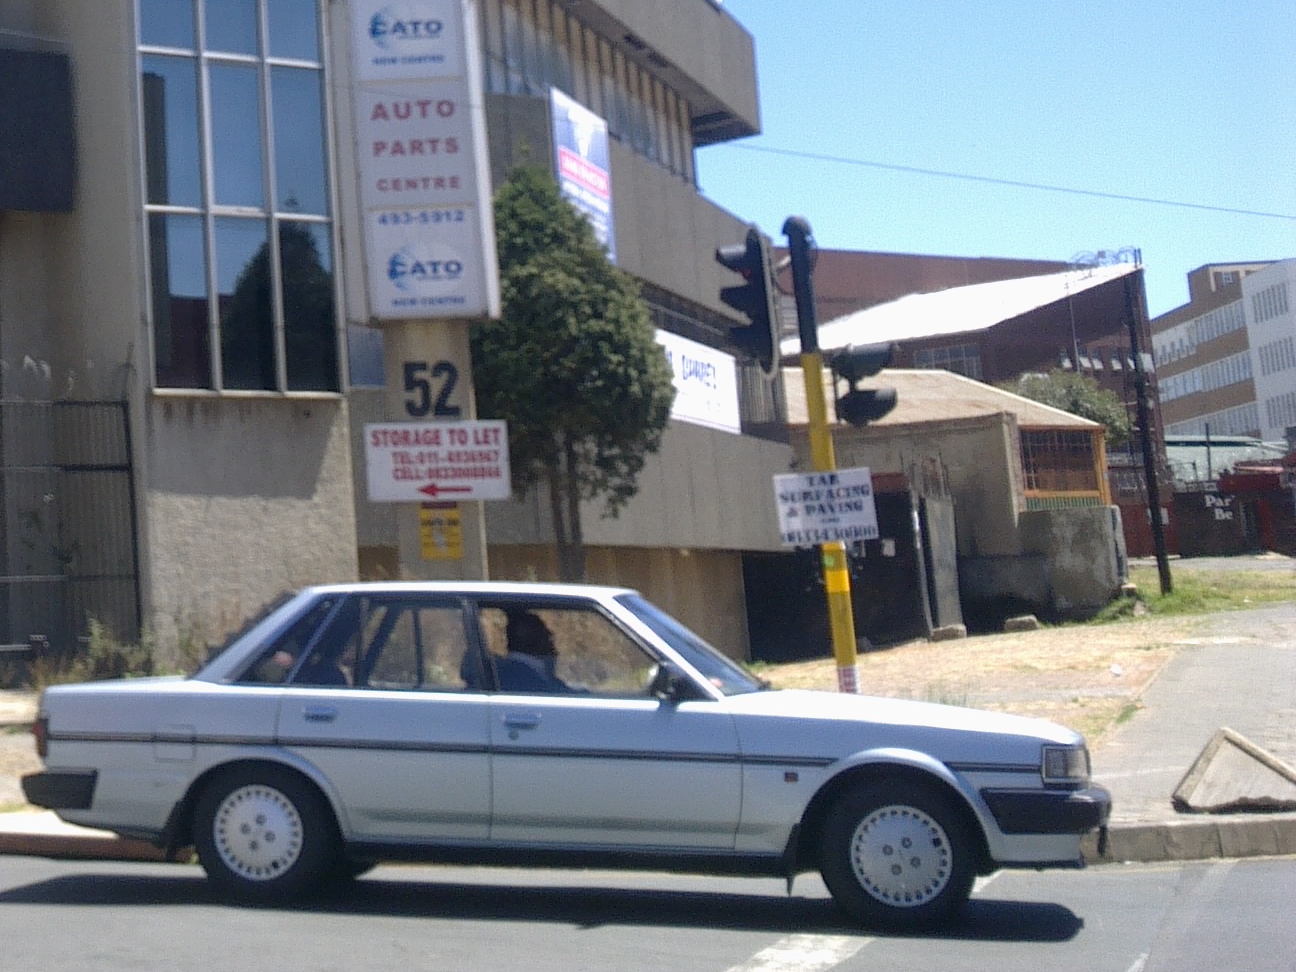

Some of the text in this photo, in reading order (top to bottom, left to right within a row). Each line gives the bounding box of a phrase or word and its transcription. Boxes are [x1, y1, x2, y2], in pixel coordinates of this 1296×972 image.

[370, 99, 455, 121] AUTO
[371, 137, 460, 157] PARTS
[376, 175, 460, 192] CENTRE
[403, 360, 461, 417] 52
[371, 428, 500, 447] STORAGE TO LET
[781, 485, 869, 502] SURFACING
[806, 500, 863, 515] PAVING
